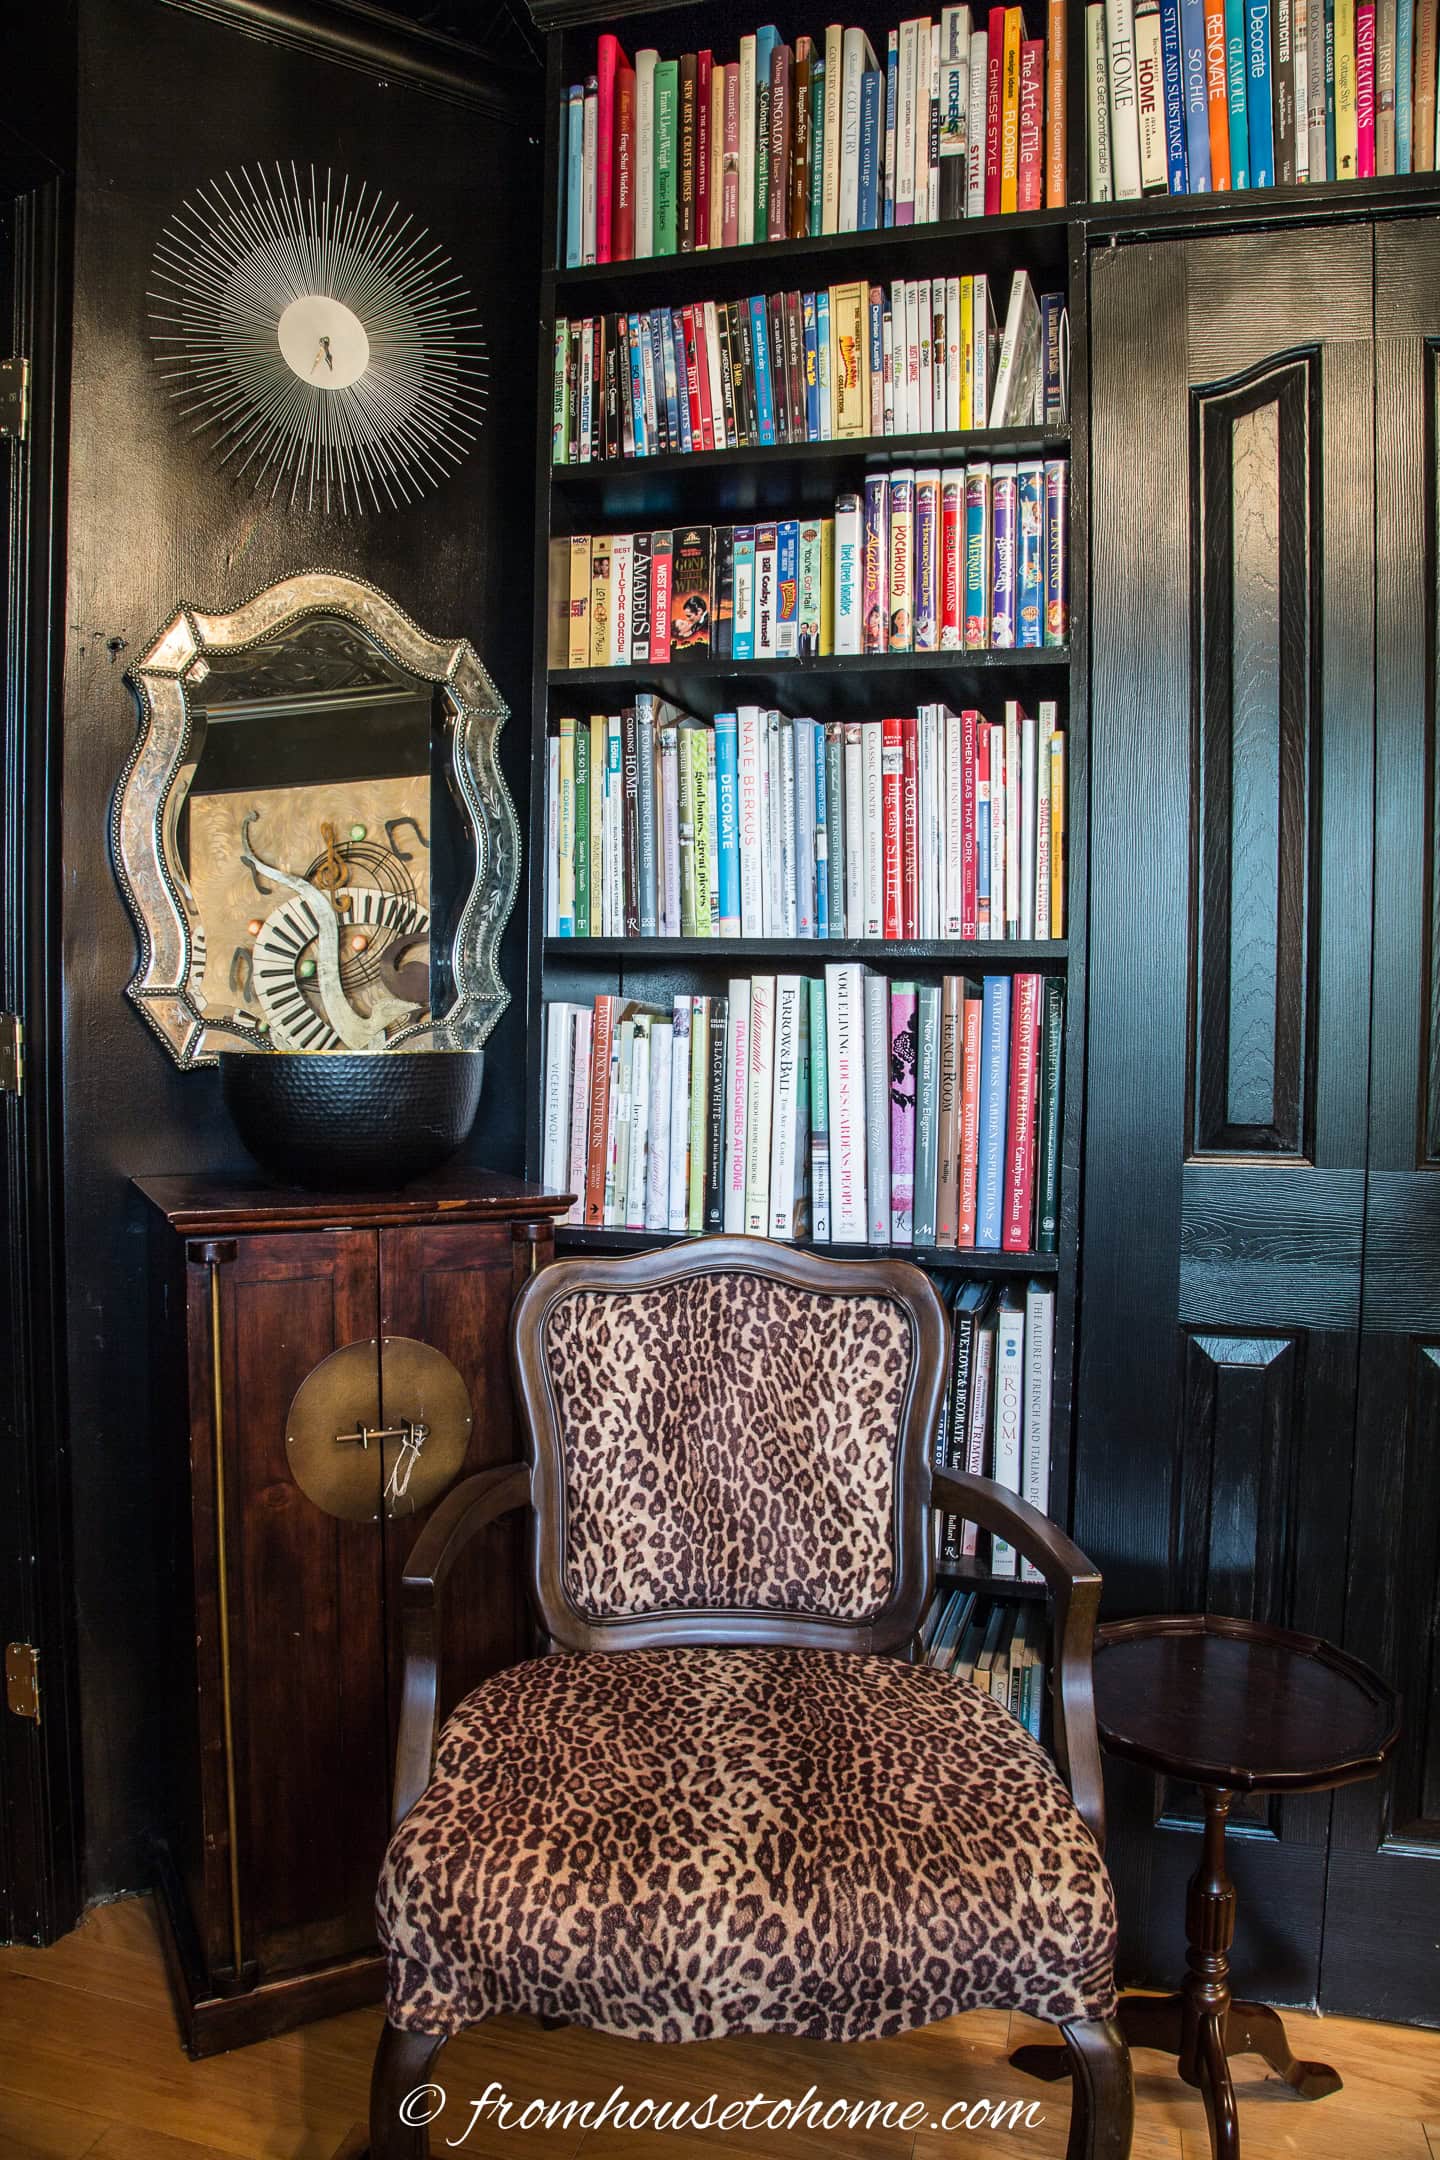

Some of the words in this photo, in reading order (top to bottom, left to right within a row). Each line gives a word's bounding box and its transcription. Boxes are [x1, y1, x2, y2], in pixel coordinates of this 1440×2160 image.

[1164, 8, 1176, 52] STYLE
[1250, 5, 1267, 78] Decorate
[1022, 50, 1035, 77] The
[1097, 58, 1106, 83] Let's
[1112, 39, 1133, 110] HOME
[1167, 54, 1179, 82] AND
[1188, 49, 1202, 71] SO
[1207, 14, 1226, 100] RENOVATE
[1339, 55, 1349, 88] Cottage
[1358, 14, 1372, 128] INSPIRATIONS
[1379, 43, 1391, 83] IRISH
[684, 80, 692, 98] NEW
[865, 78, 875, 94] the
[989, 59, 999, 124] CHINESE
[1139, 59, 1155, 114] HOME
[1190, 74, 1204, 113] CHIC
[1229, 38, 1244, 114] GLAMOUR
[659, 90, 670, 115] Frank
[728, 75, 736, 119] Romantic
[828, 92, 836, 124] COLOR
[947, 71, 959, 134] KITCHENS
[1022, 80, 1039, 111] Art
[1054, 70, 1062, 119] Influential
[1097, 86, 1106, 105] Get
[1341, 90, 1350, 112] Style
[659, 116, 670, 141] Lloyd
[684, 103, 692, 124] ARTS
[760, 92, 768, 136] Colonial
[773, 87, 783, 155] BUNGALOW
[864, 99, 874, 144] southern
[1022, 113, 1033, 127] of
[1168, 85, 1182, 160] SUBSTANCE
[619, 134, 628, 151] Feng
[727, 121, 736, 143] Style
[1004, 110, 1015, 179] FLOORING
[1021, 127, 1038, 163] Tile
[1053, 122, 1062, 161] Country
[1098, 107, 1108, 174] Comfortable
[620, 153, 628, 171] Shui
[658, 140, 670, 169] Wright
[684, 136, 692, 167] CRAFTS
[759, 138, 767, 174] Revival
[862, 148, 873, 187] cottage
[970, 145, 979, 190] STYLE
[988, 128, 997, 176] STYLE
[619, 172, 628, 208] Workbook
[659, 171, 669, 199] Prairie
[684, 170, 692, 202] HOUSES
[758, 176, 767, 209] House
[814, 174, 822, 206] STYLE
[1053, 163, 1062, 193] Styles
[659, 200, 669, 231] Houses
[908, 290, 918, 304] Wii
[976, 283, 984, 298] Wii
[554, 370, 563, 413] SIDEWAYS
[687, 366, 697, 394] HITCH
[762, 557, 771, 572] Bill
[804, 549, 812, 574] You've
[841, 544, 854, 560] Fried
[866, 522, 880, 591] Aladdin
[892, 526, 911, 596] POCAHONTAS
[966, 534, 983, 590] MERMAID
[618, 563, 626, 610] VICTOR
[657, 564, 666, 588] WEST
[841, 562, 854, 582] Green
[947, 553, 955, 611] DALMATIANS
[633, 552, 650, 635] AMADEUS
[657, 591, 666, 609] SIDE
[760, 576, 770, 606] Cosby,
[840, 583, 854, 616] Tomatoes
[656, 611, 666, 639] STORY
[761, 610, 770, 647] Himself
[578, 739, 586, 755] not
[626, 717, 634, 752] COMING
[743, 721, 754, 768] NATE
[578, 758, 585, 768] so
[641, 730, 650, 785] ROMANTIC
[576, 770, 587, 784] big
[626, 755, 636, 799] HOME
[694, 771, 705, 797] good
[576, 786, 587, 837] remodeling
[641, 789, 650, 830] FRENCH
[696, 800, 705, 836] bones.
[721, 774, 733, 849] DECORATE
[744, 776, 755, 847] BERKUS
[905, 777, 915, 827] PORCH
[1039, 798, 1049, 838] SMALL
[643, 833, 651, 868] HOMES
[697, 840, 708, 868] great
[905, 830, 915, 883] LIVING
[965, 832, 973, 863] WORK
[1039, 841, 1048, 880] SPACE
[699, 873, 708, 907] pieces
[1038, 883, 1048, 921] LIVING
[598, 1005, 609, 1041] BARRY
[924, 1019, 933, 1042] New
[966, 1013, 977, 1053] Creating
[1020, 991, 1031, 1042] PASSION
[713, 1040, 722, 1077] BLACK
[735, 1020, 745, 1067] ITALIAN
[943, 1014, 958, 1069] FRENCH
[1020, 1046, 1030, 1069] FOR
[595, 1044, 608, 1084] DIXON
[923, 1044, 933, 1080] Orleans
[966, 1064, 976, 1092] Home
[550, 1063, 559, 1110] VICENTE
[712, 1083, 722, 1120] WHITE
[734, 1069, 744, 1135] DESIGNERS
[923, 1082, 932, 1105] New
[942, 1072, 957, 1113] ROOM
[593, 1087, 605, 1148] INTERIORS
[1016, 1072, 1029, 1143] INTERIORS
[549, 1114, 558, 1145] WOLF
[920, 1107, 931, 1147] Elegance
[963, 1103, 973, 1151] KATHRYN
[734, 1138, 743, 1153] AT
[733, 1155, 742, 1191] HOME
[1012, 1146, 1025, 1186] Carolyne
[962, 1167, 972, 1213] IRELAND
[1012, 1188, 1022, 1221] Roehm
[1032, 1301, 1043, 1321] THE
[1032, 1324, 1043, 1360] ALLURE
[958, 1350, 969, 1378] LOVE
[1032, 1362, 1042, 1376] OF
[1030, 1378, 1041, 1418] FRENCH
[954, 1389, 965, 1444] DECORATE
[1002, 1378, 1016, 1456] ROOMS
[1030, 1422, 1040, 1443] AND
[1030, 1446, 1040, 1484] ITALIAN
